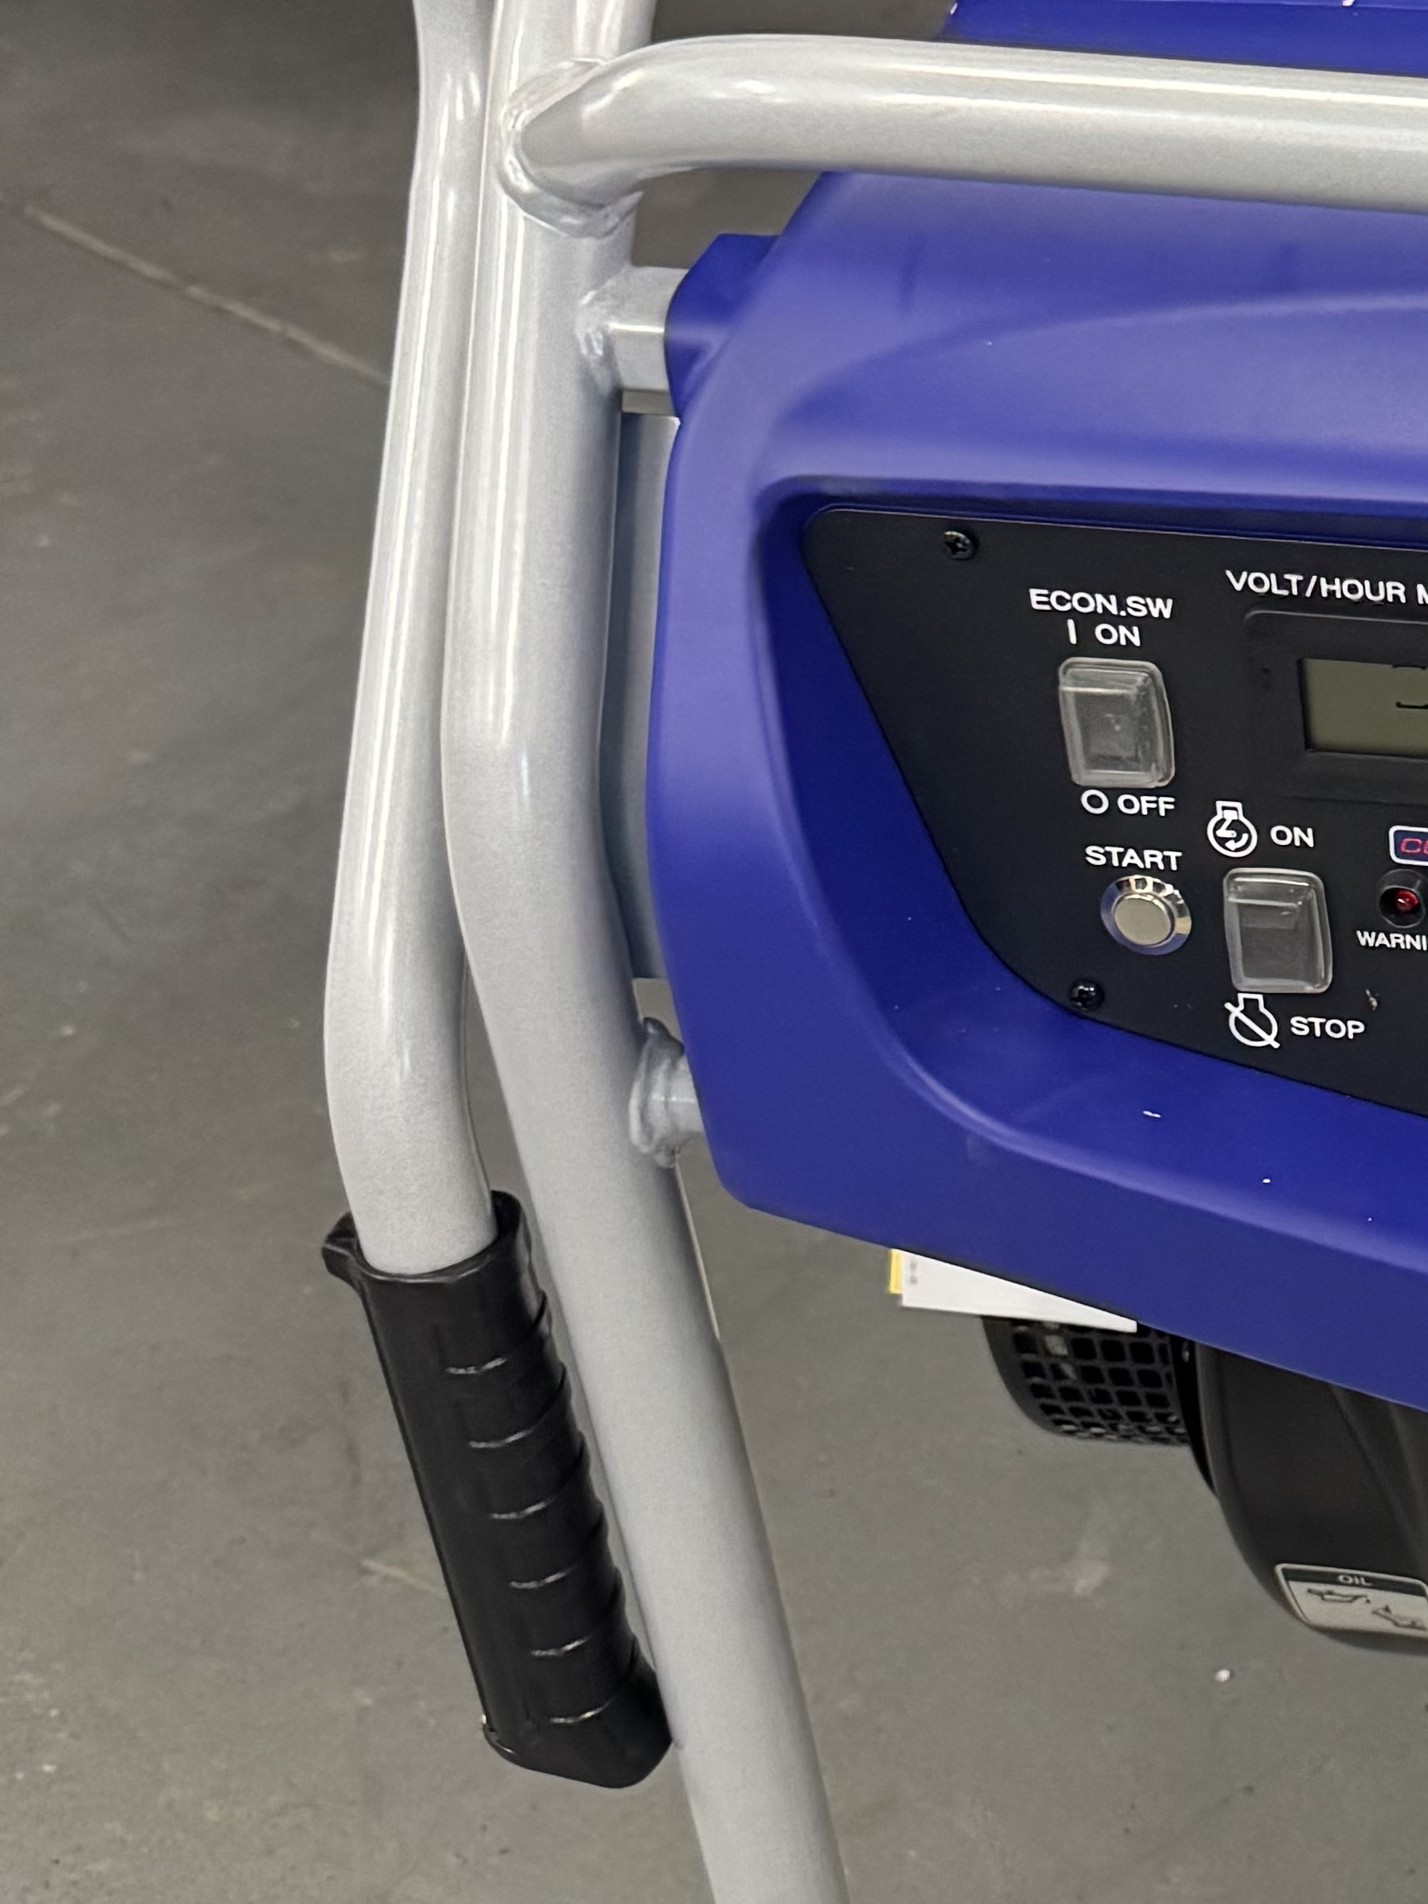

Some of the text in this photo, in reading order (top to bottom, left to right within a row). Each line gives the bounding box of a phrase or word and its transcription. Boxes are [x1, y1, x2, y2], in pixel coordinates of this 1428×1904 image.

[1225, 569, 1406, 604] VOLT/HOUR
[1028, 588, 1173, 619] ECON.SW
[1094, 623, 1141, 647] ON
[1117, 793, 1176, 817] OFF
[1270, 825, 1314, 848] ON
[1085, 845, 1183, 871] START
[1290, 1015, 1365, 1040] STOP
[1338, 1574, 1374, 1588] OIL
